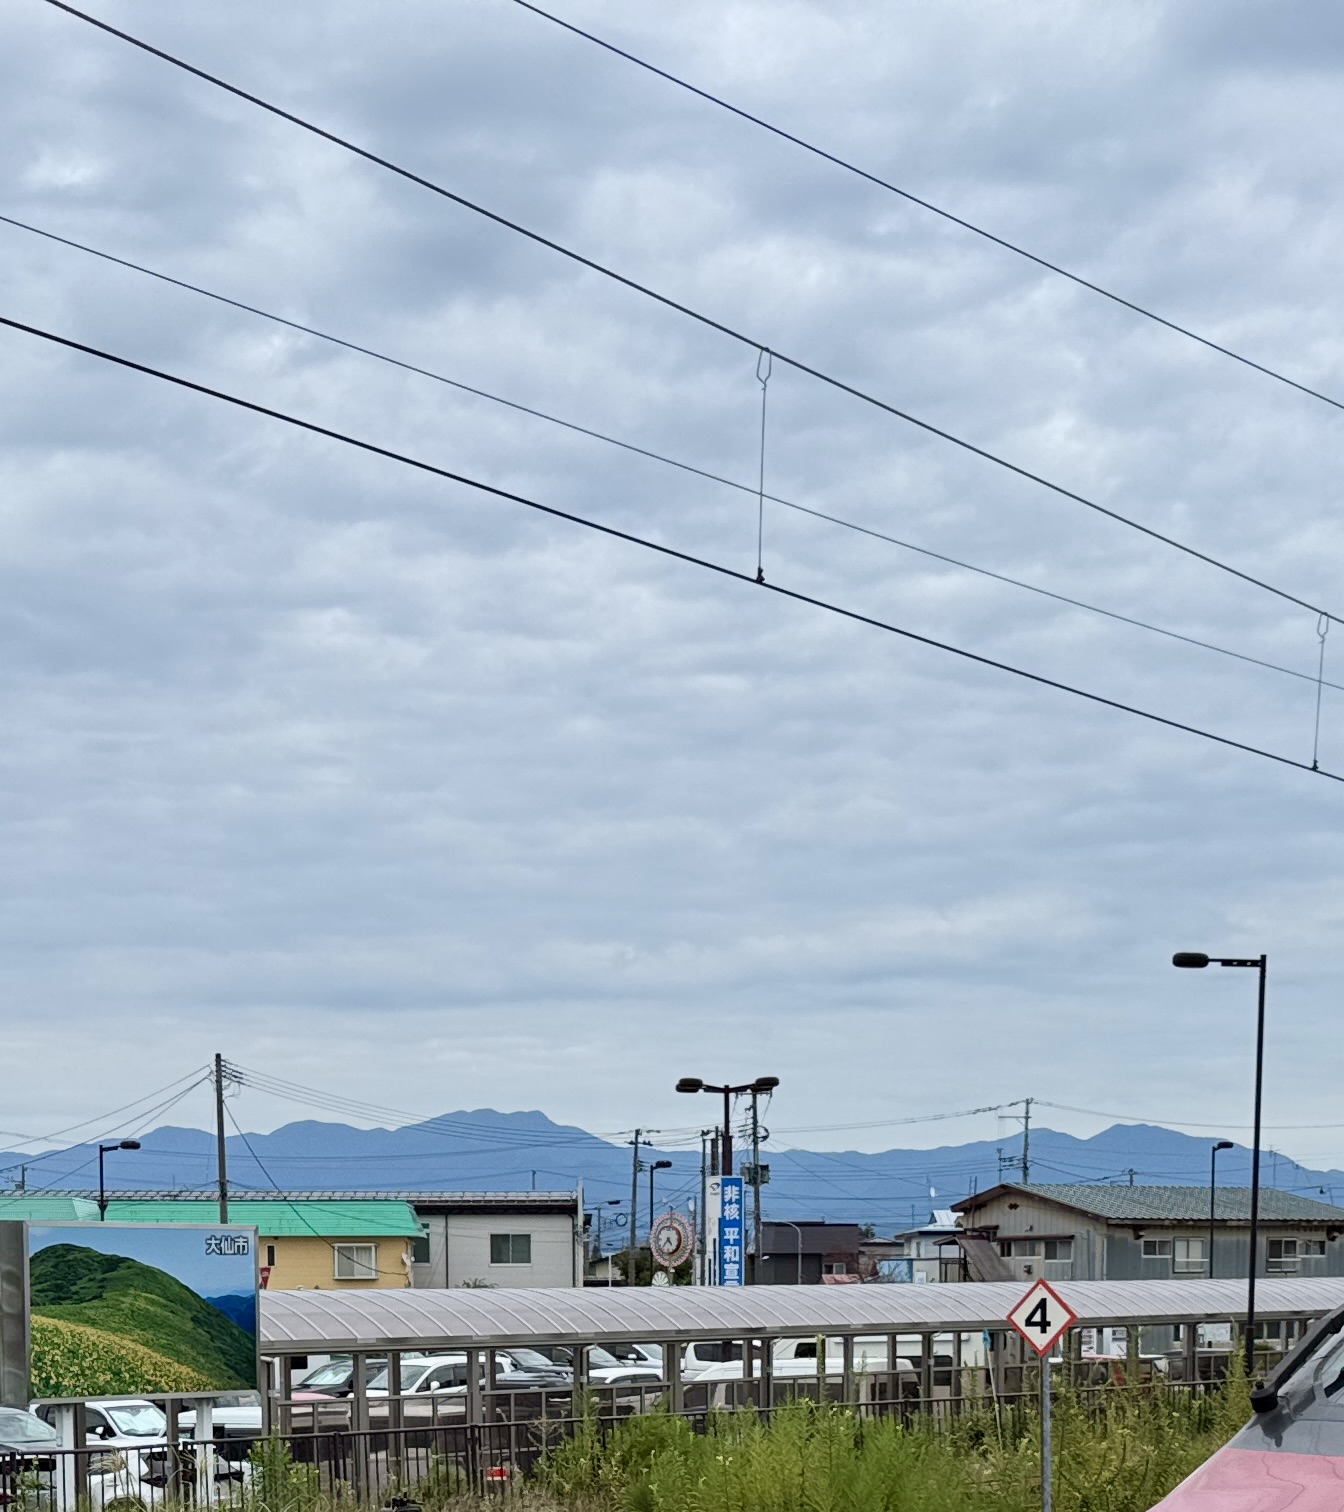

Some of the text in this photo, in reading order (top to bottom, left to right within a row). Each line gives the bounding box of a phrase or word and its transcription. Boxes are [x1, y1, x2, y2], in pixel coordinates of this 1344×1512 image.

[206, 1236, 248, 1254] 大仙市
[723, 1185, 740, 1286] 非核 平和宣
[1025, 1298, 1051, 1334] 4
